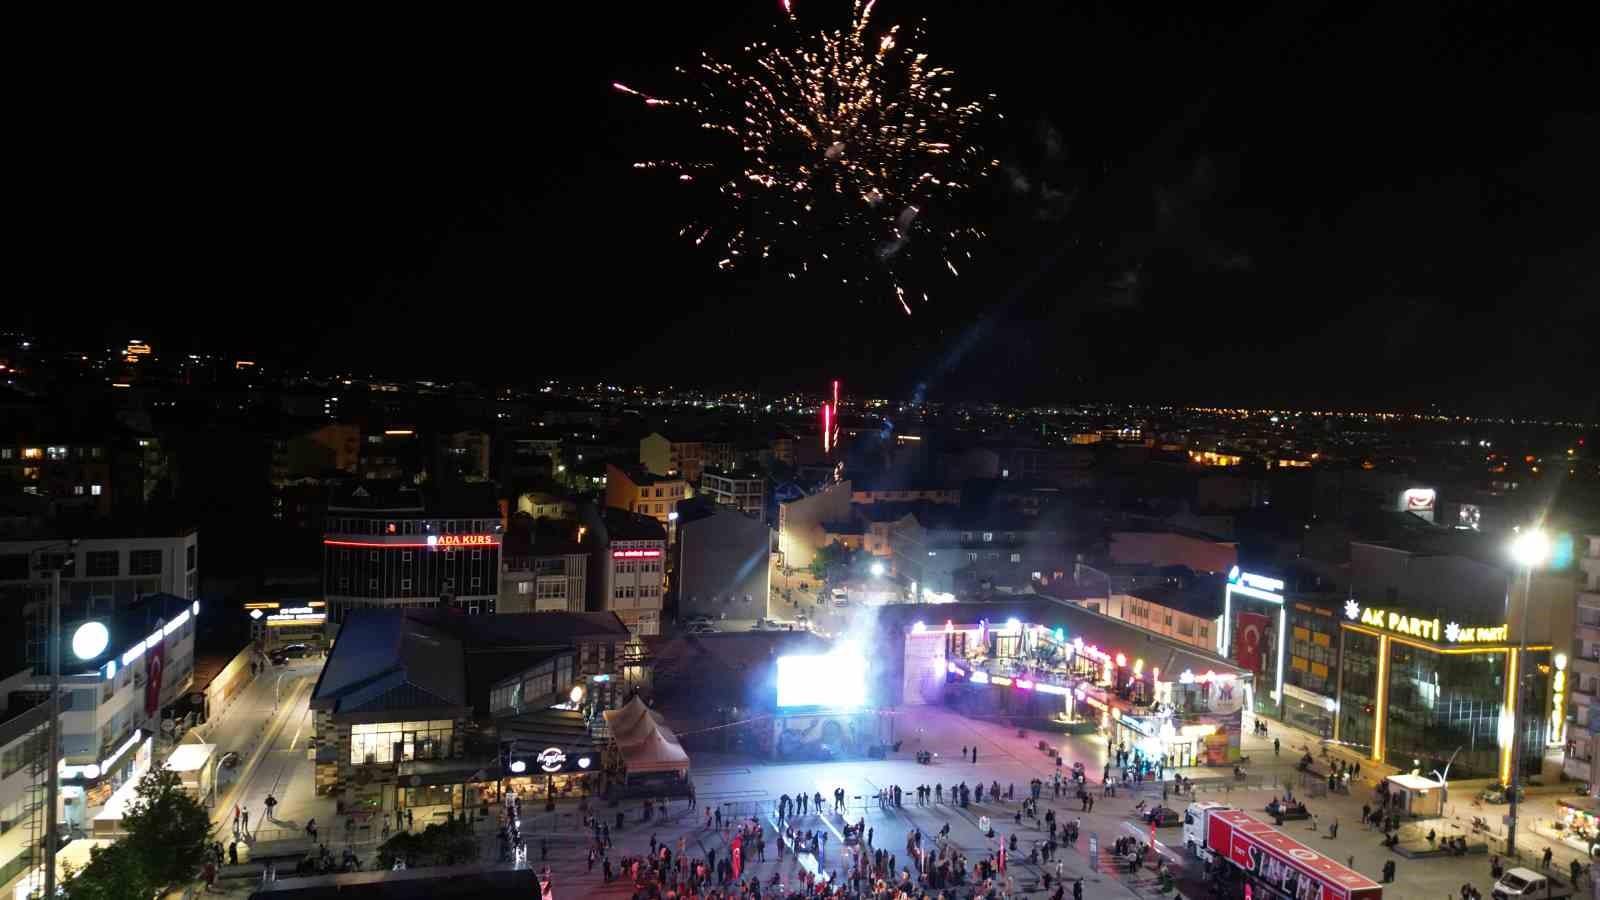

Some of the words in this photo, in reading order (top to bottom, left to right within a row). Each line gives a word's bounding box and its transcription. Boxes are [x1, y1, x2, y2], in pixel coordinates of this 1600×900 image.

[438, 535, 460, 545] ADA
[463, 535, 492, 544] KURS
[1361, 607, 1385, 628] AK
[1388, 612, 1440, 641] PARTİ
[1457, 628, 1475, 642] AK
[1476, 624, 1508, 642] PARTİ
